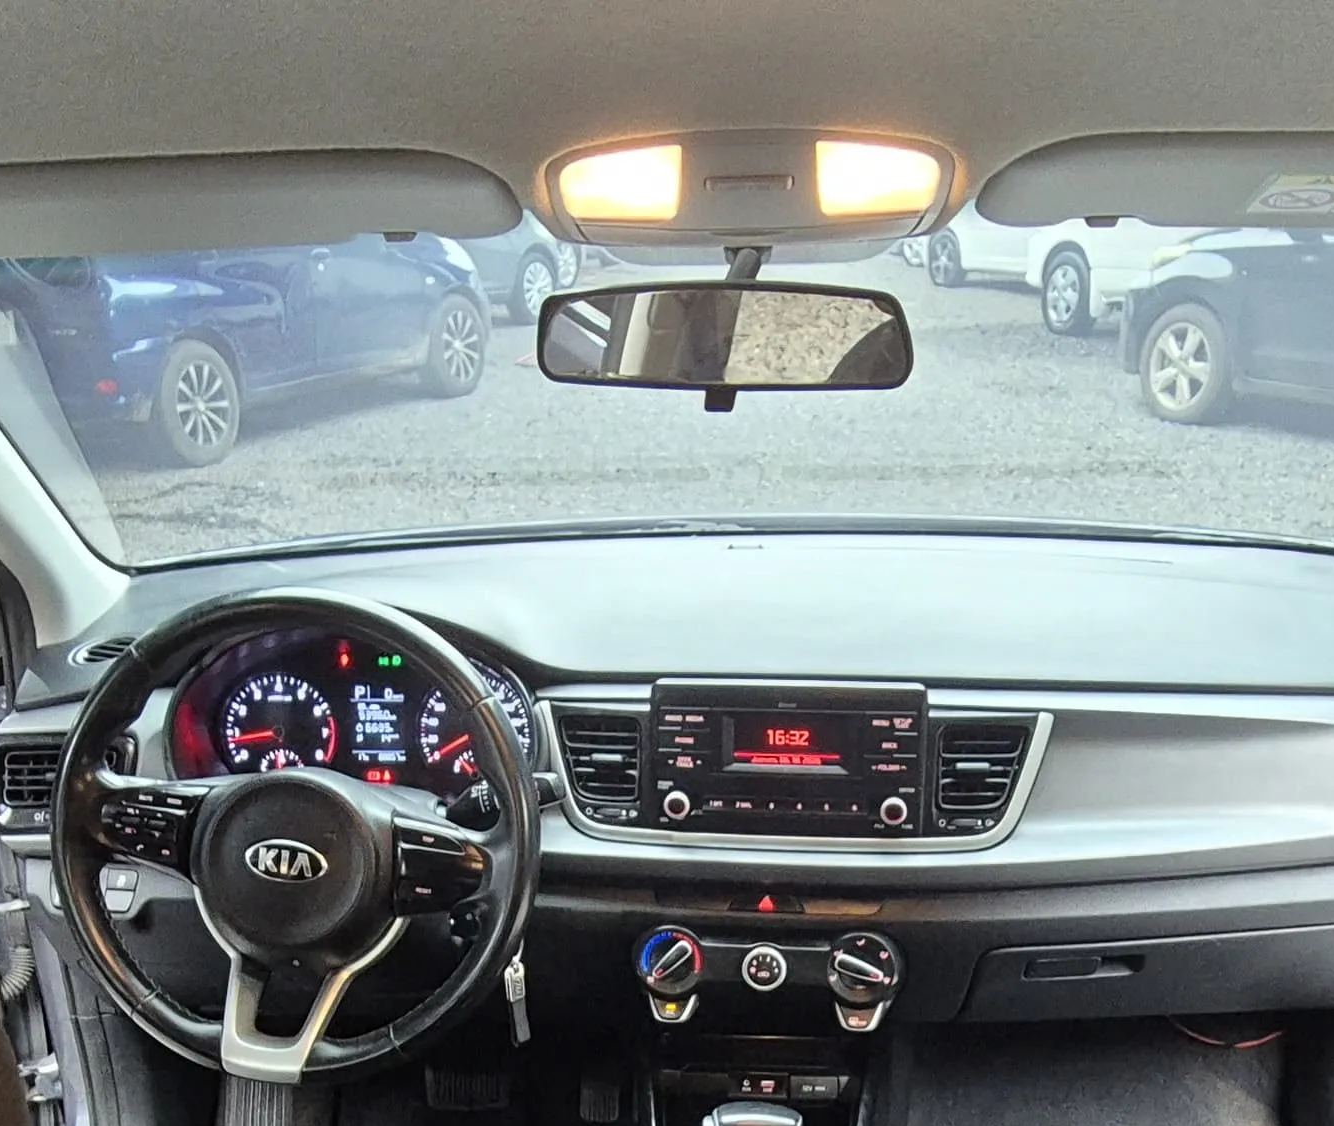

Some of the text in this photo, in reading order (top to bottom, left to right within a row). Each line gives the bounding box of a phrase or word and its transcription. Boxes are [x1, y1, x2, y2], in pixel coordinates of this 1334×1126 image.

[354, 684, 366, 700] P
[767, 729, 810, 746] 16:32
[257, 846, 313, 878] KIA
